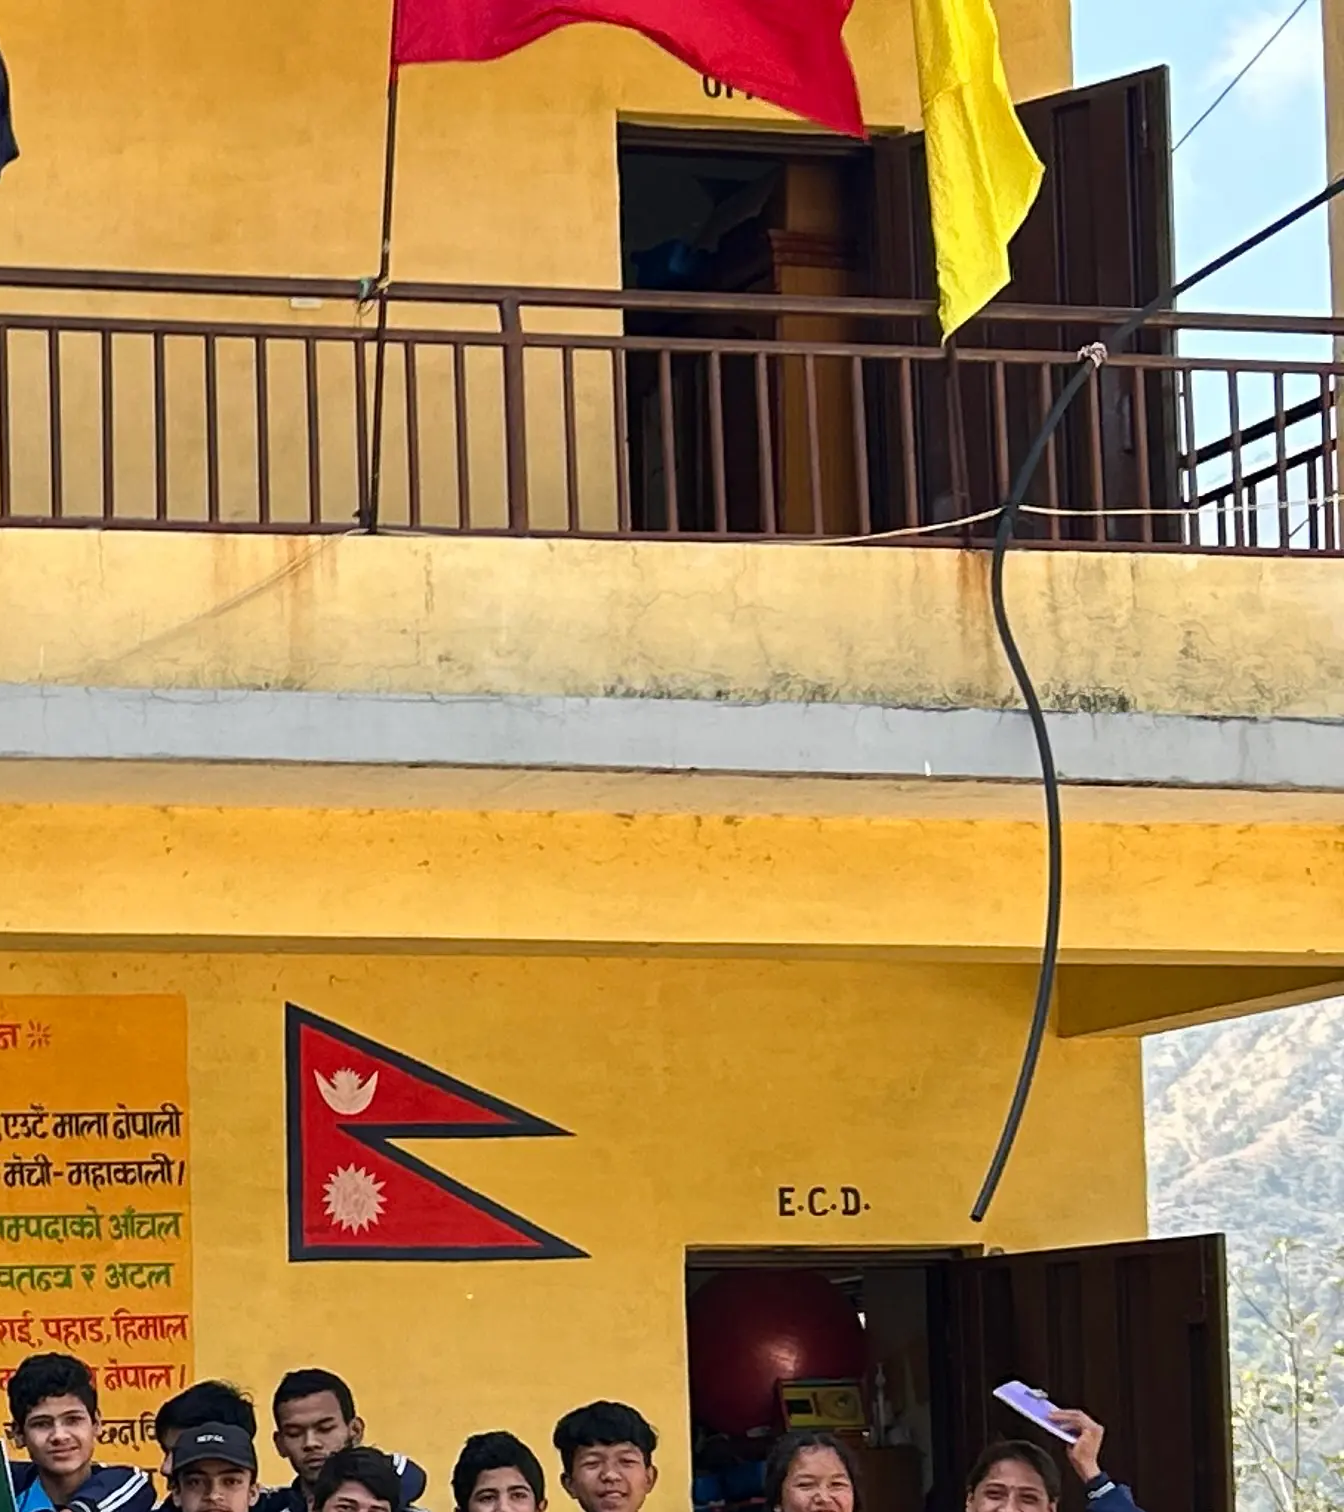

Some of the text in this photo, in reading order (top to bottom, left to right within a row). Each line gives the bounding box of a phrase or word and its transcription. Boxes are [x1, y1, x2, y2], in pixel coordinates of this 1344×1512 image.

[52, 1112, 110, 1142] माला
[113, 1102, 183, 1141] नेपाली
[778, 1186, 872, 1217] E.C.D.
[79, 1264, 97, 1291] र
[104, 1262, 176, 1291] अटल
[111, 1307, 190, 1349] हिमाल
